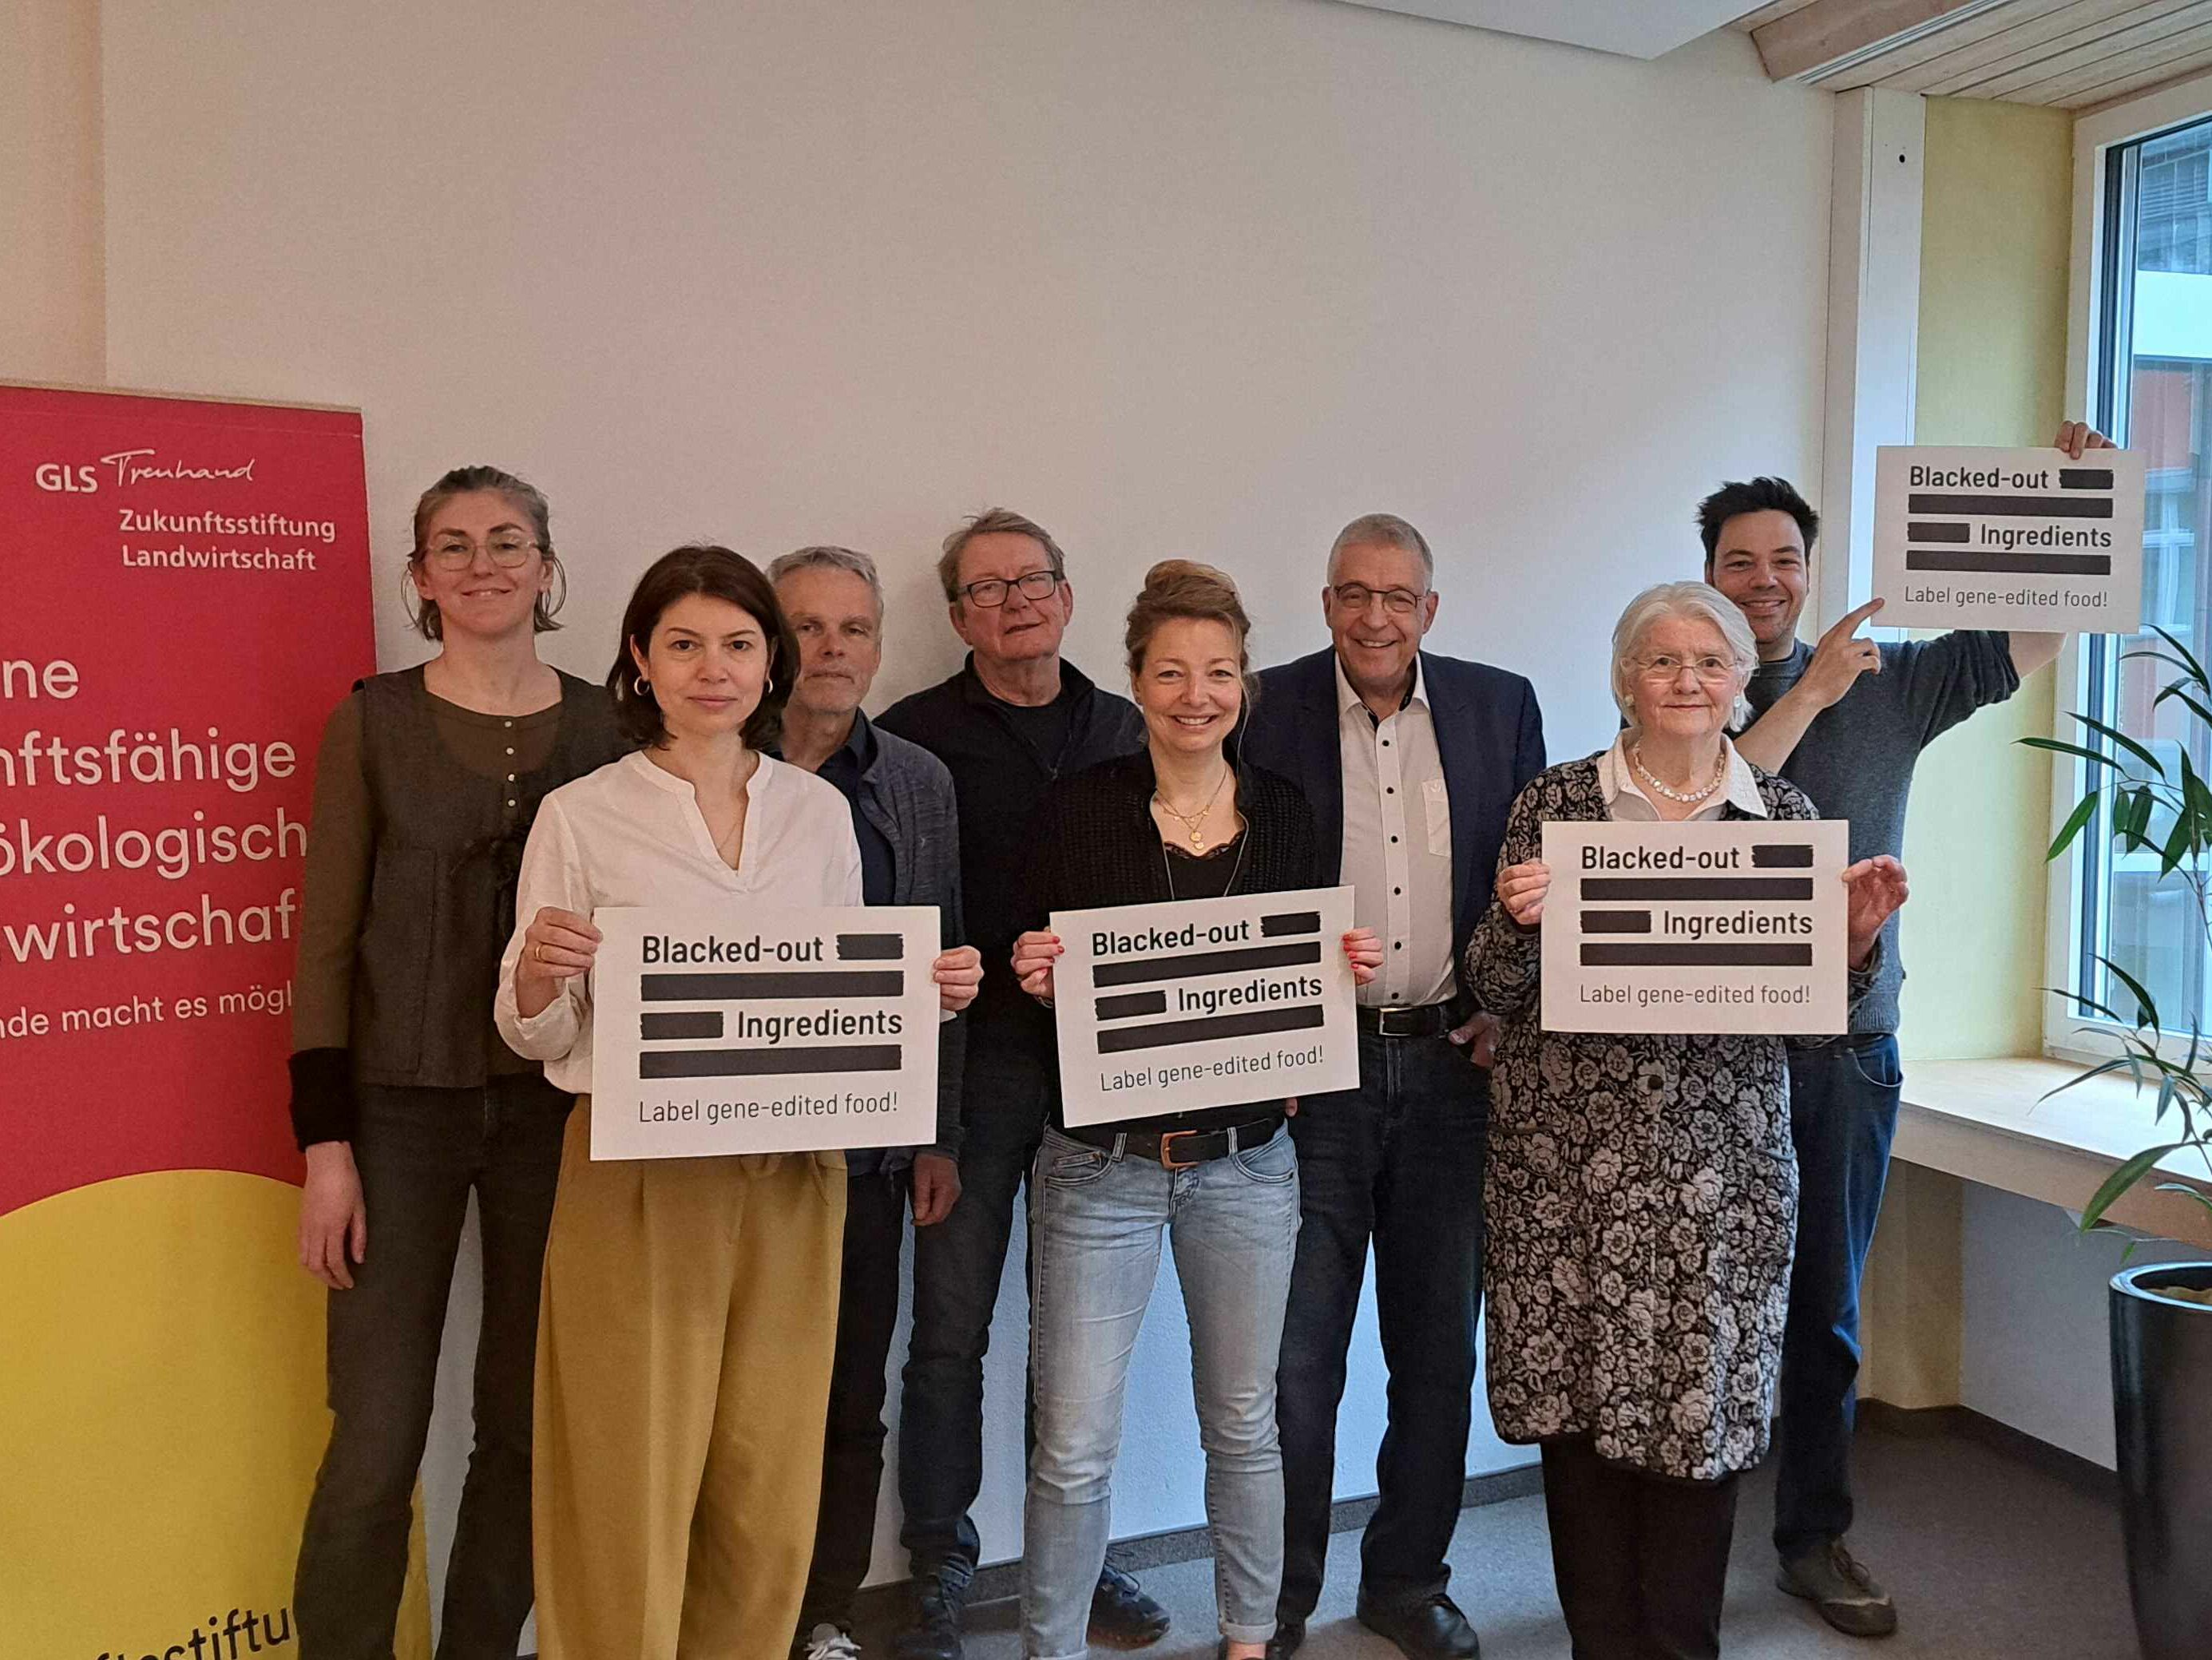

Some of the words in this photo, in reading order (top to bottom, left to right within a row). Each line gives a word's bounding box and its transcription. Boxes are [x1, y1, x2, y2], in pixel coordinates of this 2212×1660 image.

[35, 463, 98, 493] GLS
[101, 449, 256, 487] Treuhand
[1910, 466, 2049, 489] Blacked-out
[119, 509, 336, 542] Zukunftsstiftung
[1981, 523, 2111, 550] Ingredients
[122, 545, 316, 570] Landwirtschaft
[1905, 585, 1950, 603] Label
[1956, 588, 2059, 608] gene-edited
[2063, 590, 2108, 608] food!
[2, 660, 79, 699] ne
[1581, 846, 1740, 870] Blacked-out
[2, 888, 295, 963] wirtschaf
[1092, 920, 1250, 957] Blacked-out
[1664, 909, 1813, 941] Ingredients
[642, 935, 823, 964] Blacked-out
[61, 995, 165, 1032] macht
[174, 997, 208, 1019] es
[219, 980, 291, 1015] mögl
[1178, 976, 1322, 1015] Ingredients
[1580, 984, 1631, 1004] Label
[1637, 985, 1754, 1008] gene-edited
[1760, 985, 1810, 1004] food!
[738, 1008, 902, 1044] Ingredients
[1100, 1066, 1152, 1091] Label
[1158, 1052, 1271, 1088] gene-edited
[1277, 1044, 1324, 1068] food!
[640, 1099, 699, 1123] Label
[707, 1093, 838, 1126] gene-edited
[845, 1091, 898, 1114] food!
